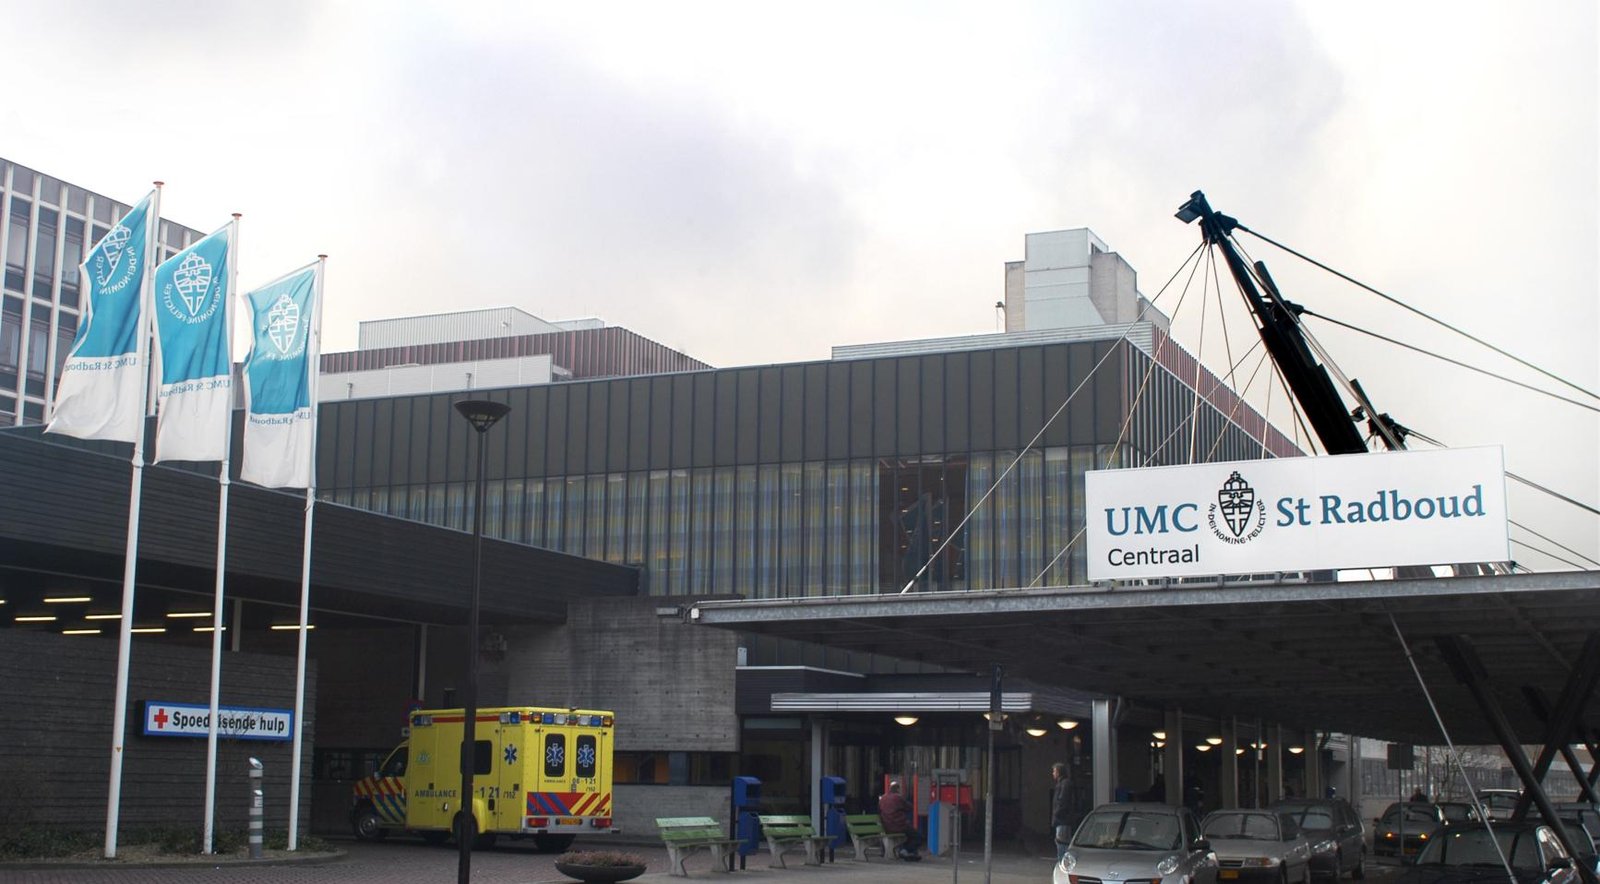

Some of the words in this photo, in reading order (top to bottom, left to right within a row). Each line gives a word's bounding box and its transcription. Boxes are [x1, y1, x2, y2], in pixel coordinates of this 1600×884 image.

[1104, 503, 1199, 536] UMC
[1276, 497, 1311, 527] St
[1320, 484, 1486, 525] Radboud
[1213, 529, 1246, 545] NOMINE
[1247, 498, 1267, 542] FELICITER
[1107, 545, 1200, 566] Centraal
[172, 711, 256, 730] Spoedisende
[259, 716, 285, 734] hulp
[414, 789, 457, 798] AMBULANCE
